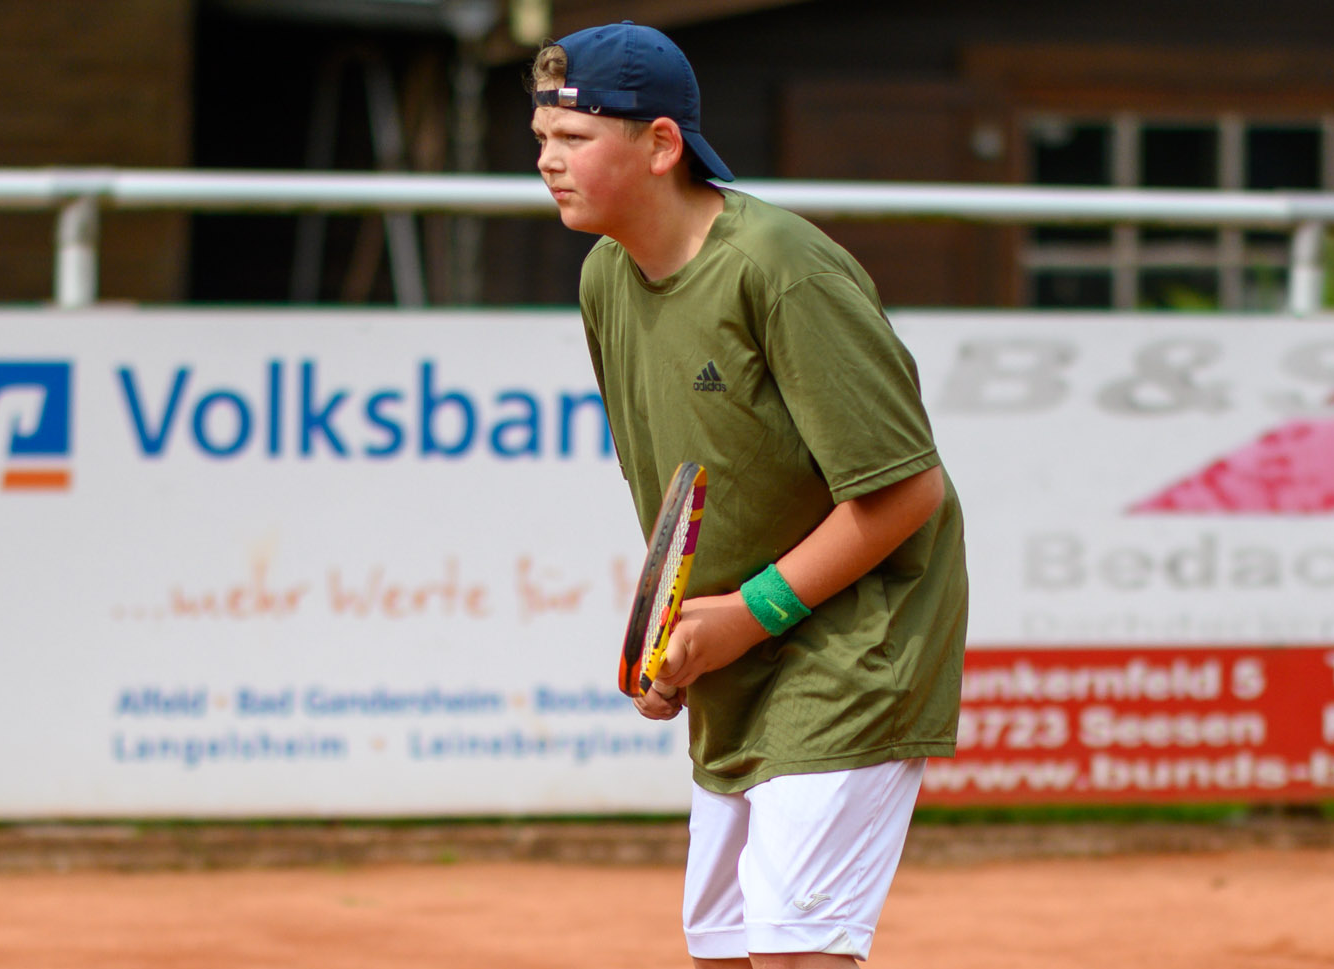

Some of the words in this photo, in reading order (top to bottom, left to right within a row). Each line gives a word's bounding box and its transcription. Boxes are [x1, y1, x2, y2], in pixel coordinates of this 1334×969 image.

[691, 378, 730, 394] adidas
[933, 340, 1078, 414] B
[1096, 340, 1236, 415] &
[114, 358, 611, 458] Volksban
[234, 686, 295, 717] Bad
